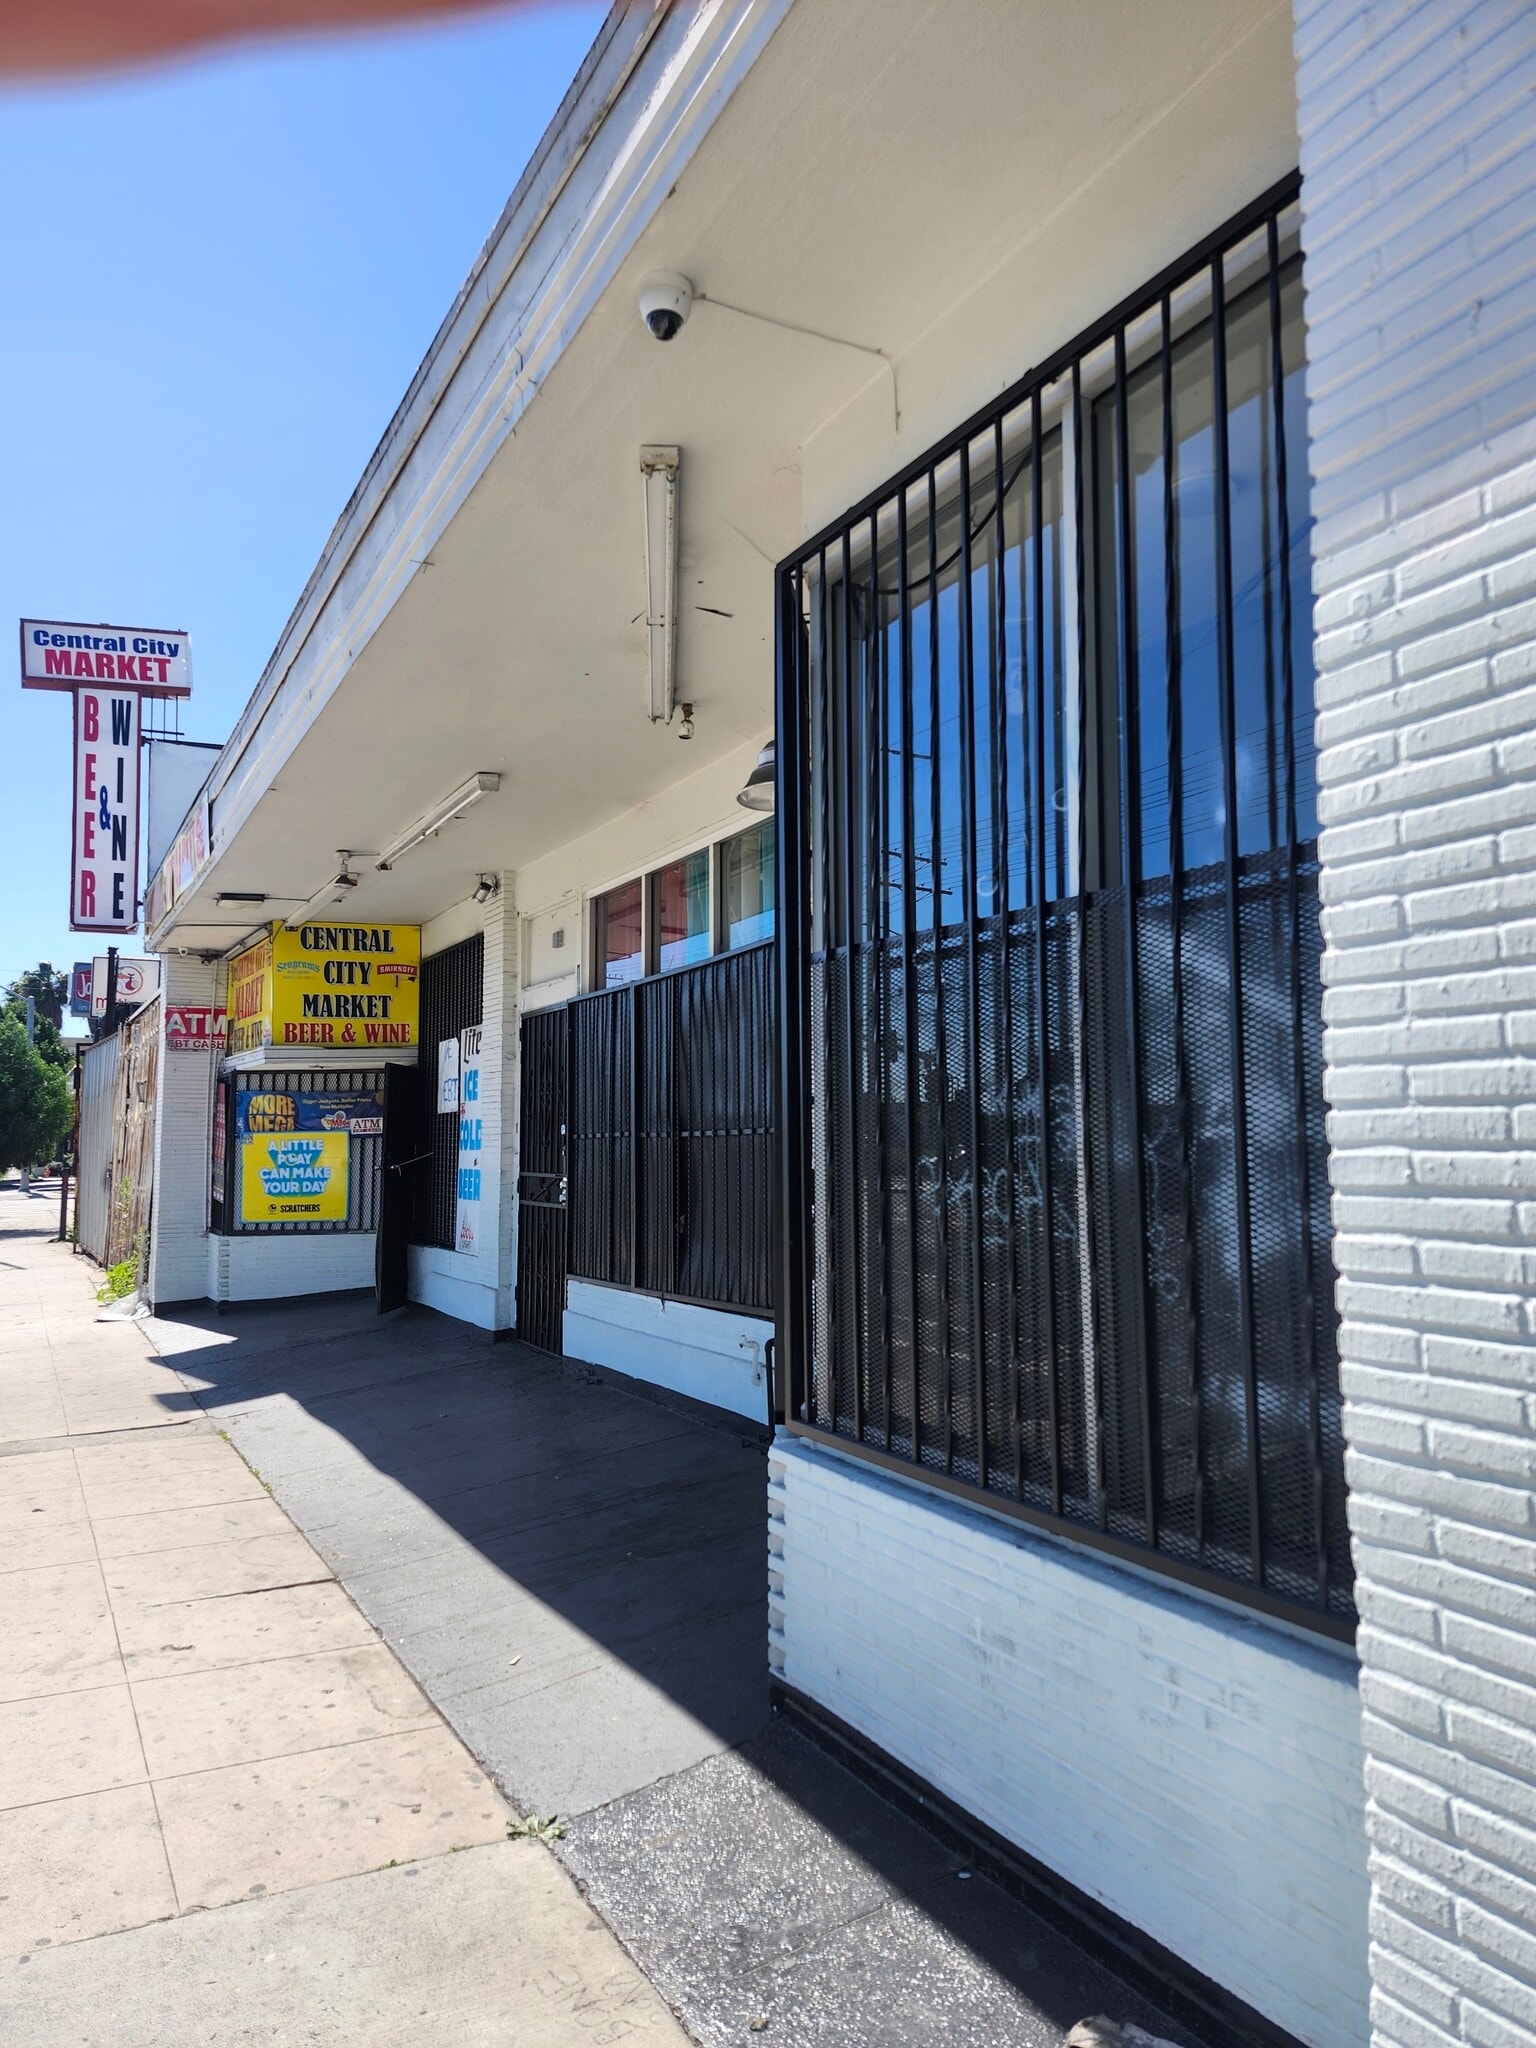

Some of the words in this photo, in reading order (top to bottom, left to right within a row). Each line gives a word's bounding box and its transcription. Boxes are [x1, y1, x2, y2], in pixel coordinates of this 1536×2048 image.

[33, 629, 126, 653] Central
[132, 637, 180, 658] City
[44, 648, 172, 683] MARKET
[80, 694, 100, 918] BEER
[111, 698, 132, 920] WINE
[300, 926, 394, 953] CENTRAL
[323, 960, 372, 985] CITY
[379, 965, 416, 974] SMIRNOFF
[302, 994, 392, 1018] MARKET
[166, 1012, 227, 1035] ATM
[284, 1022, 334, 1043] BEER
[341, 1022, 357, 1043] &
[363, 1023, 411, 1043] WINE
[167, 1040, 190, 1049] EBT
[192, 1040, 225, 1050] CASH
[463, 1028, 482, 1065] Lite
[464, 1069, 479, 1102] ICE
[248, 1094, 296, 1116] MORE
[353, 1119, 381, 1129] ATM
[267, 1140, 278, 1152] A
[280, 1139, 324, 1151] LITTLE
[259, 1168, 290, 1180] CAN
[292, 1167, 332, 1179] MAKE
[262, 1181, 300, 1194] YOUR
[302, 1180, 327, 1193] DAY
[279, 1203, 321, 1213] SCRATCHERS
